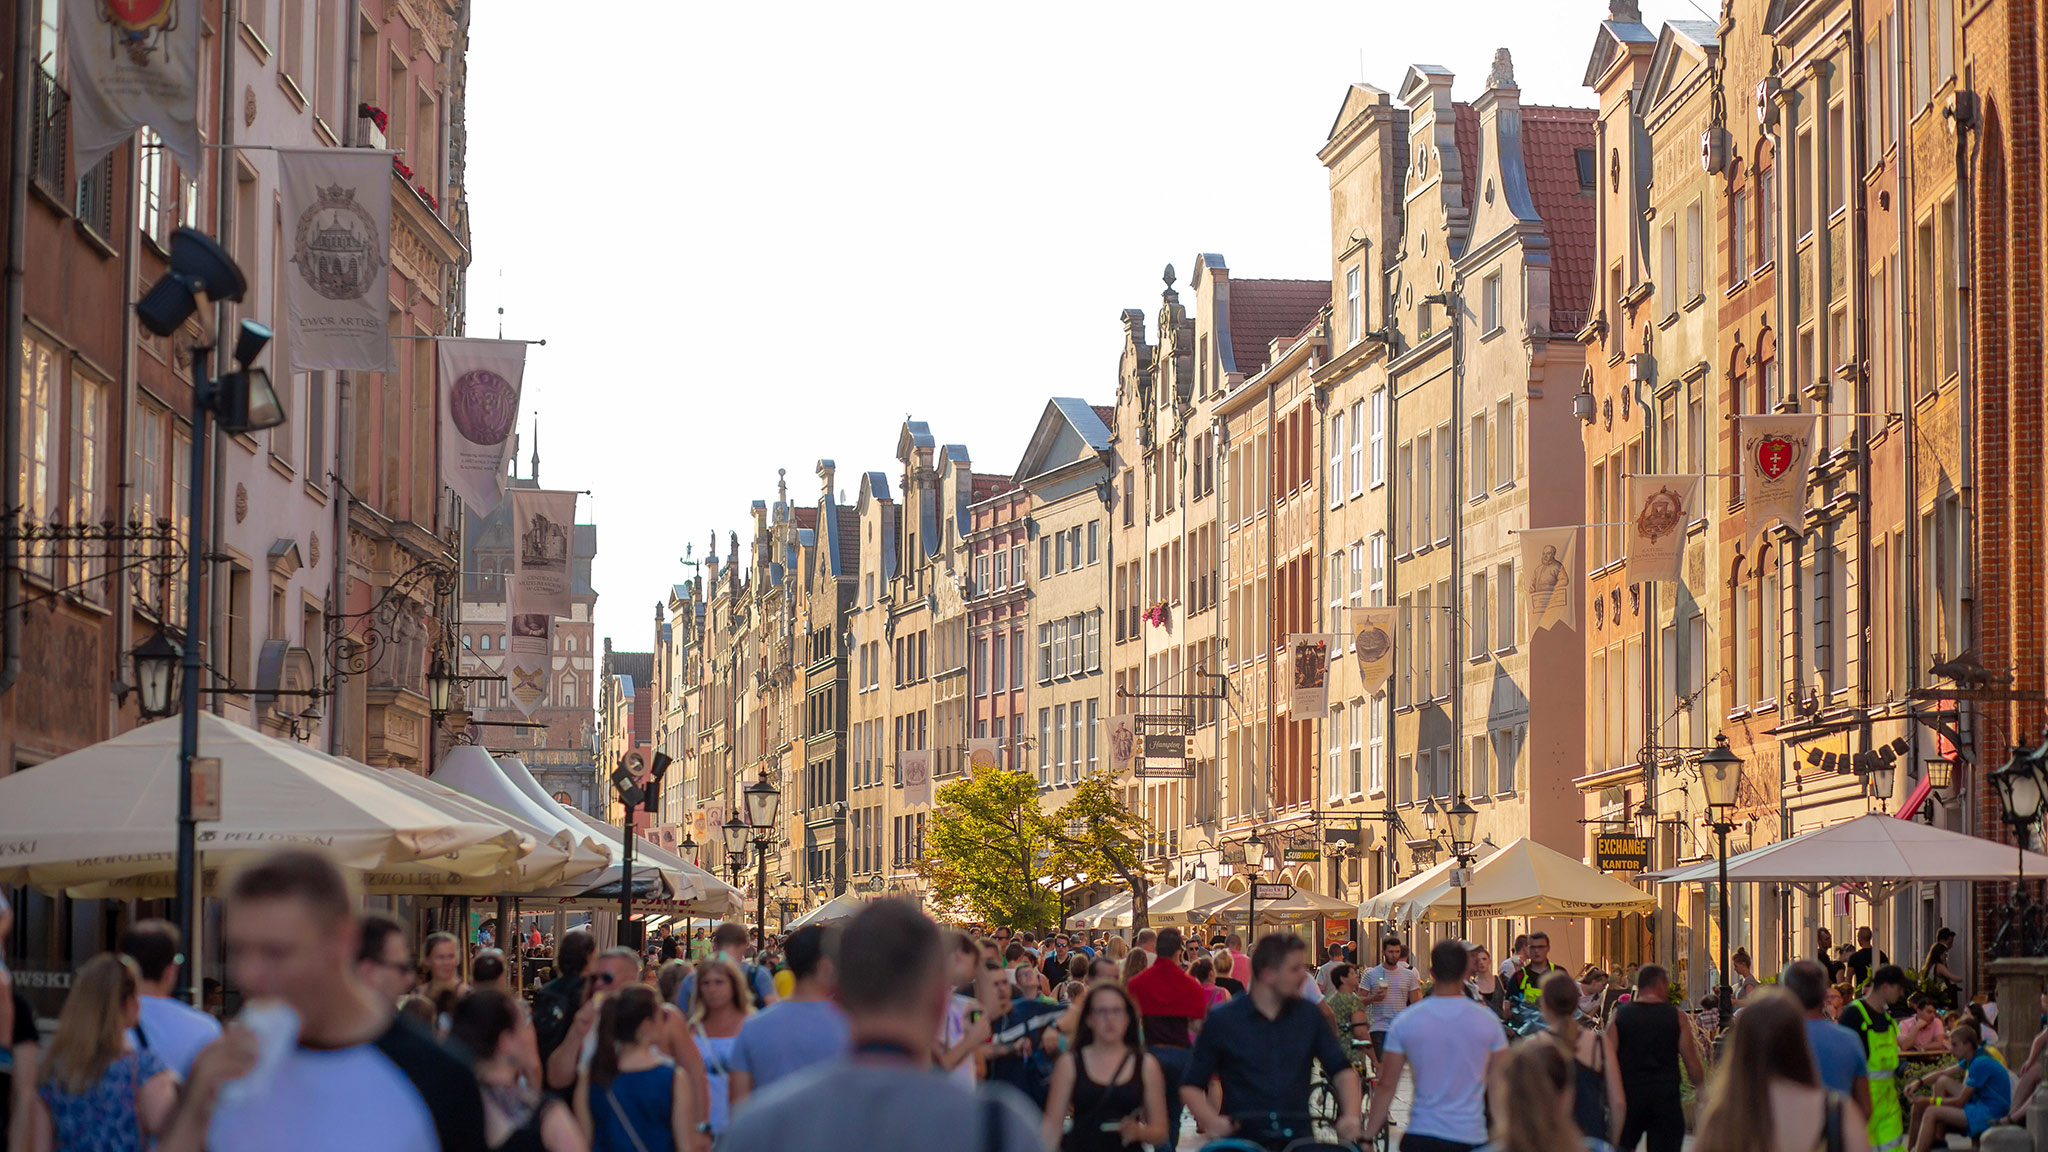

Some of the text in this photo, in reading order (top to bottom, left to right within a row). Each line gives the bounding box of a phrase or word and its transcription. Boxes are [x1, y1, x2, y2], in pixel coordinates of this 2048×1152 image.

[1149, 740, 1183, 750] Hampton
[1598, 838, 1646, 855] EXCHANGE
[1285, 851, 1319, 859] SUBWAY
[1602, 860, 1640, 869] KANTOR
